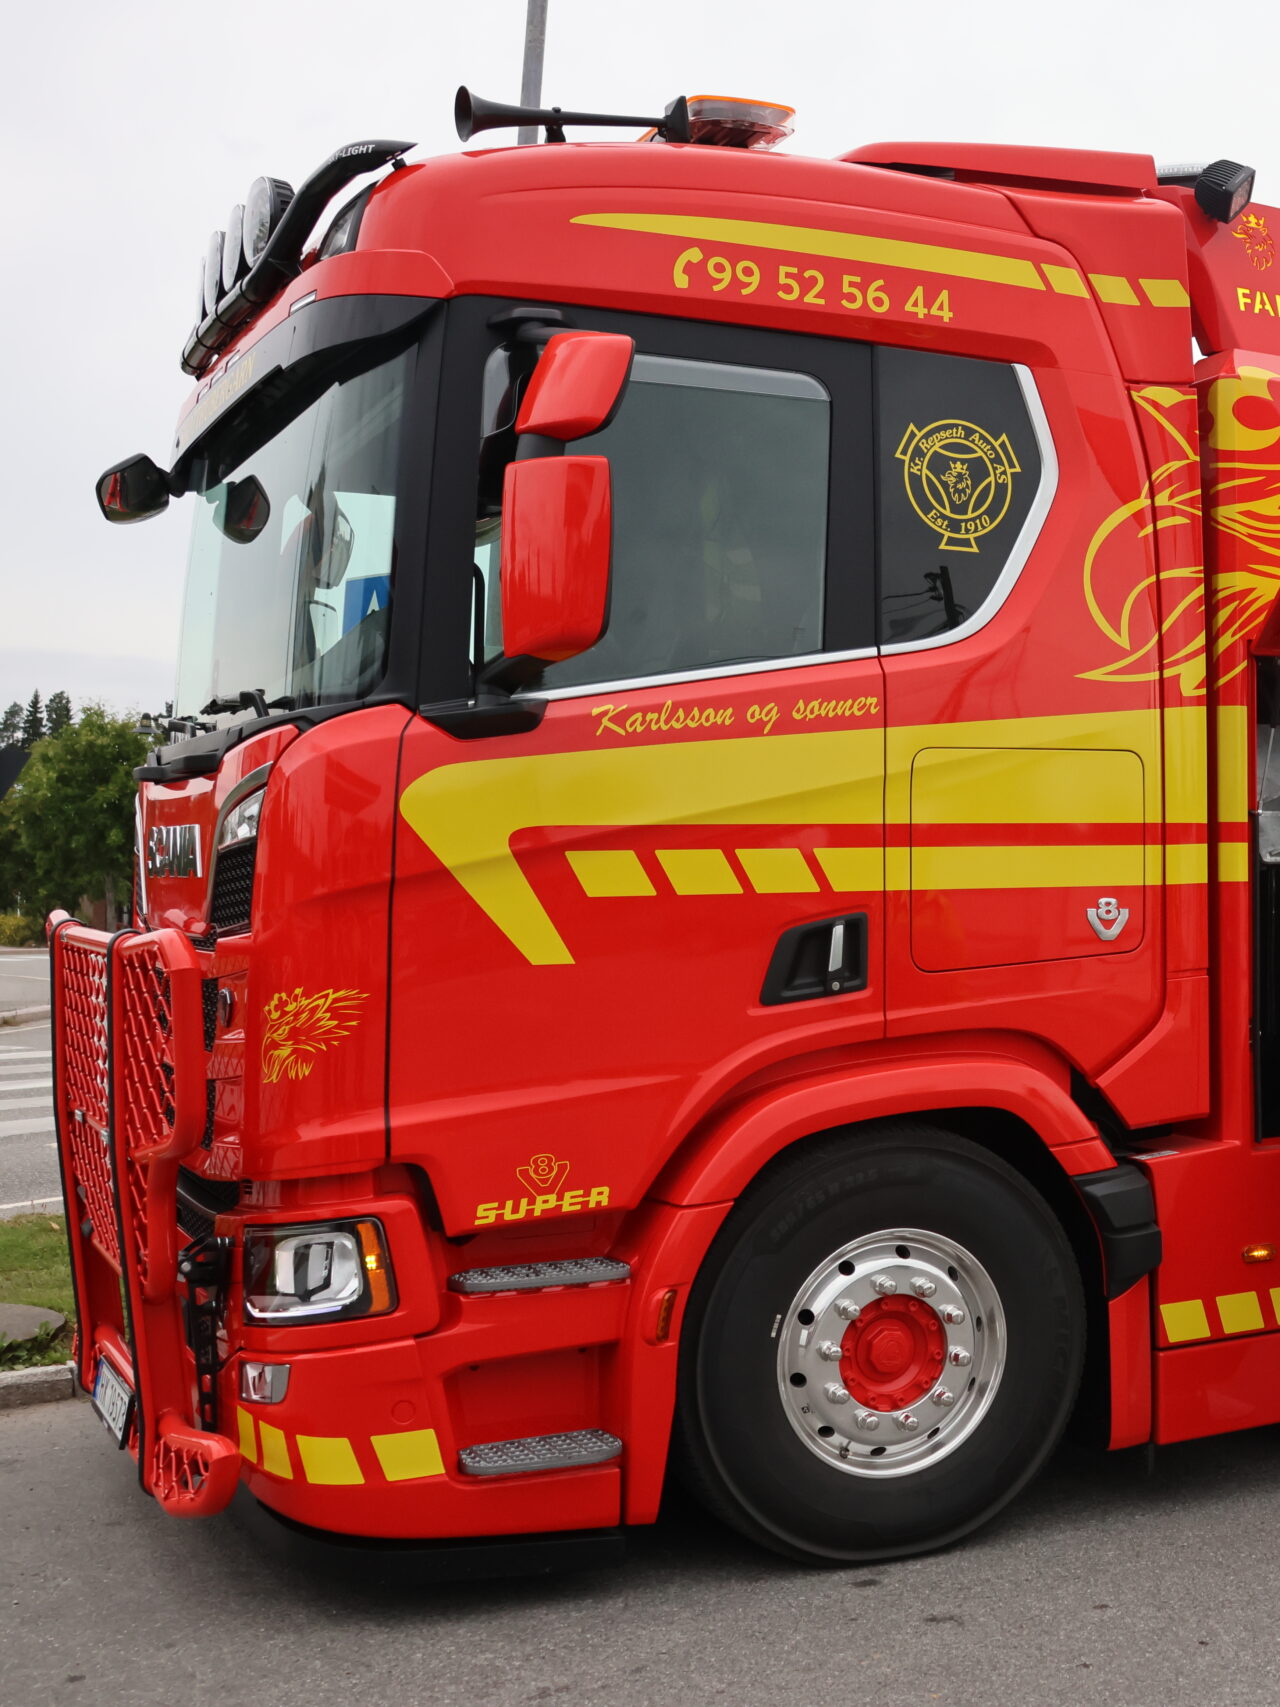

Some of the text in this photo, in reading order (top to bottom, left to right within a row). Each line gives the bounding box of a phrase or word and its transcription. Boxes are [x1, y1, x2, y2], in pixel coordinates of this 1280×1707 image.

[706, 256, 954, 323] 99 52 56 44
[910, 426, 1008, 484] Kr. Repseth Auto AS
[926, 509, 991, 534] Est. 1910
[591, 696, 880, 737] Karlsson og sønner
[474, 1186, 610, 1225] SUPER
